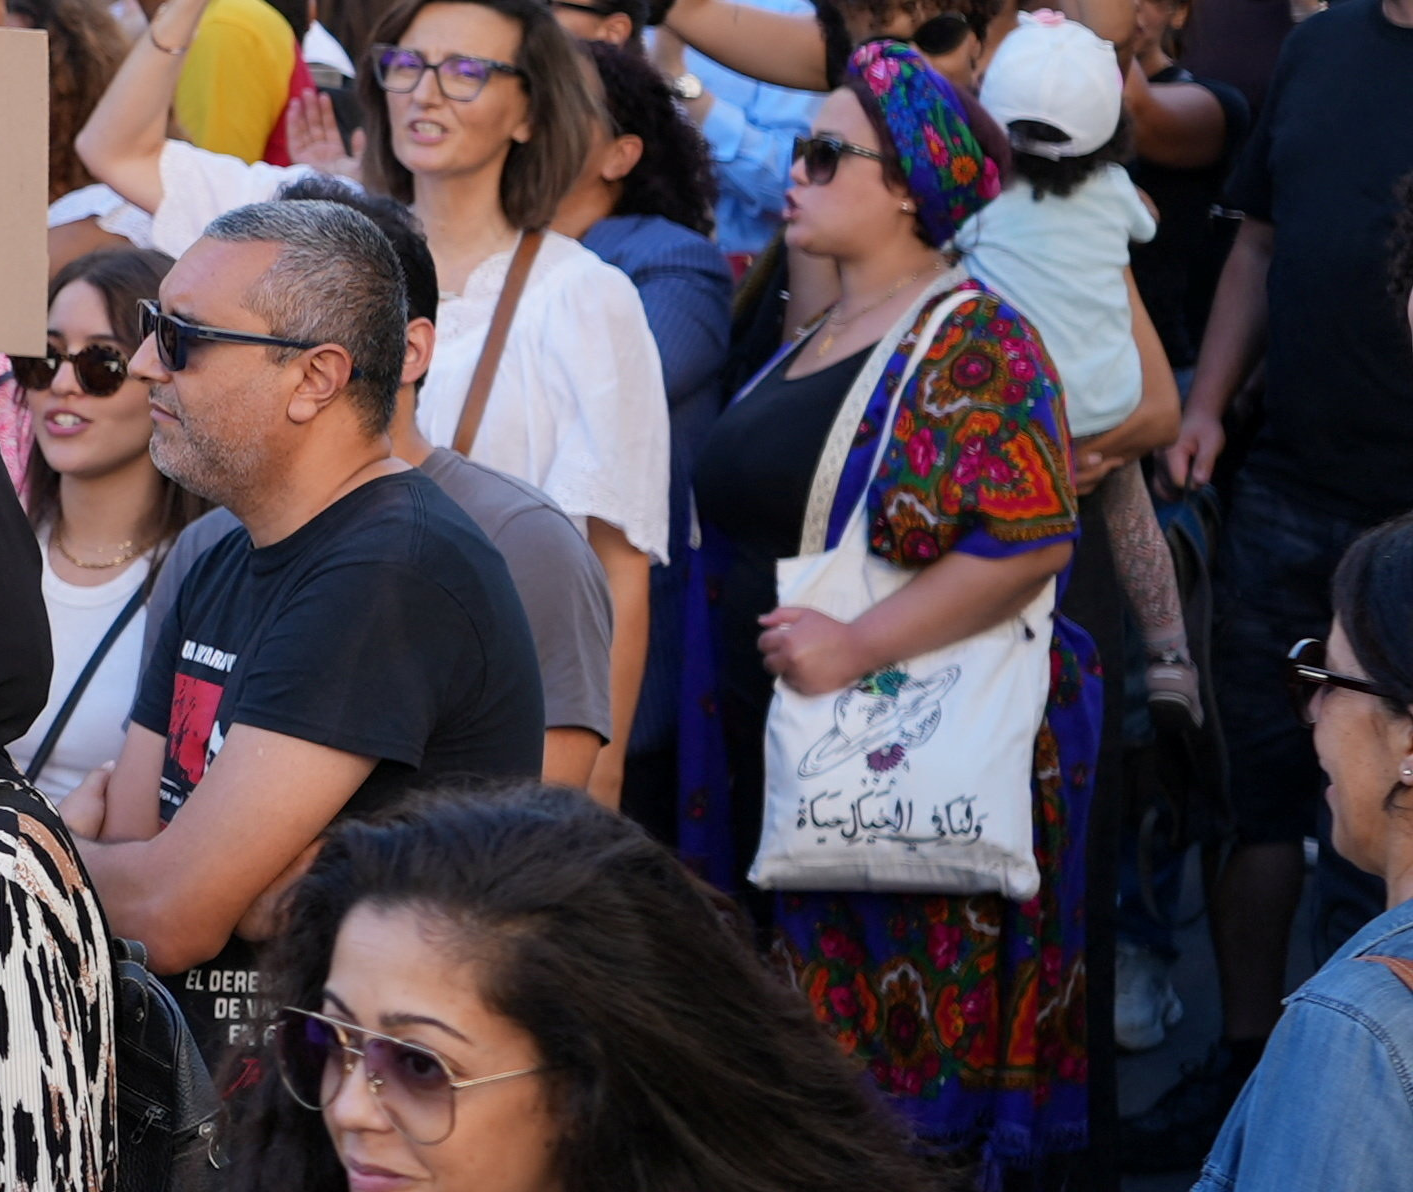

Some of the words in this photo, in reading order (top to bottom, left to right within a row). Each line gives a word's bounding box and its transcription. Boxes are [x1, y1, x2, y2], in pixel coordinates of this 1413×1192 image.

[185, 969, 205, 991] EL
[208, 969, 260, 994] DERE
[214, 997, 242, 1020] DE
